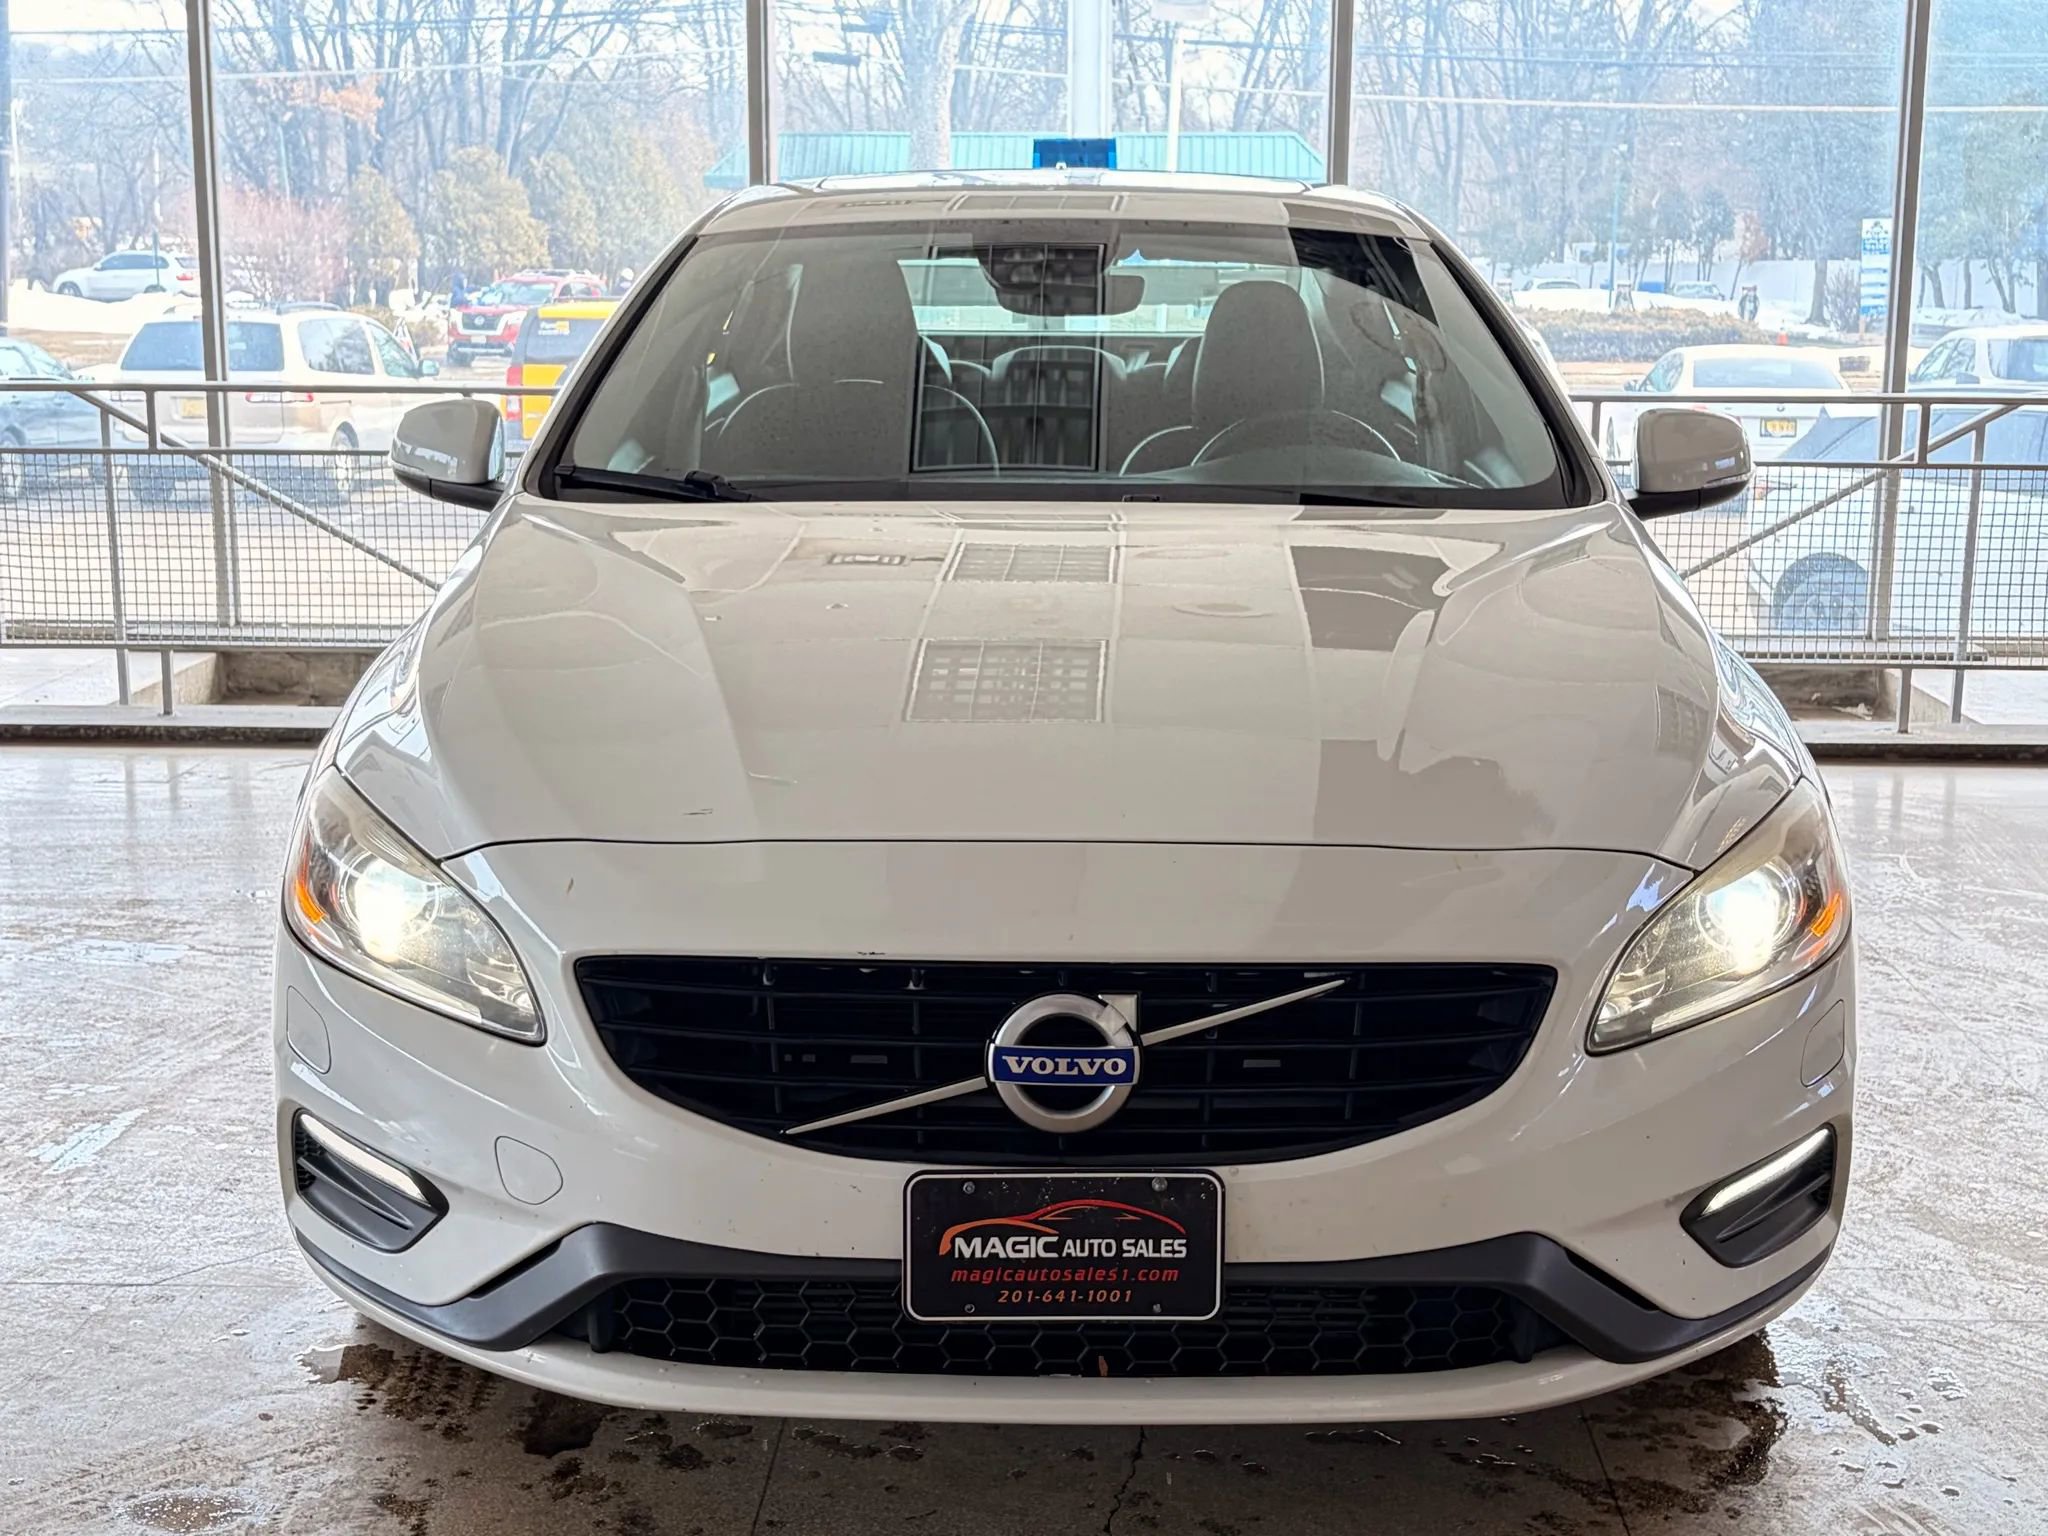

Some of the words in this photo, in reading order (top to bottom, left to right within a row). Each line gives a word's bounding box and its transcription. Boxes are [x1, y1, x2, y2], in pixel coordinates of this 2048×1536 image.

[1002, 1055, 1127, 1076] VOLVO
[954, 1236, 1060, 1259] MAGIC
[1062, 1239, 1117, 1258] AUTO
[1122, 1238, 1188, 1259] SALES
[951, 1266, 1179, 1284] magicautosales1.com
[998, 1290, 1132, 1303] 201-641-1001
